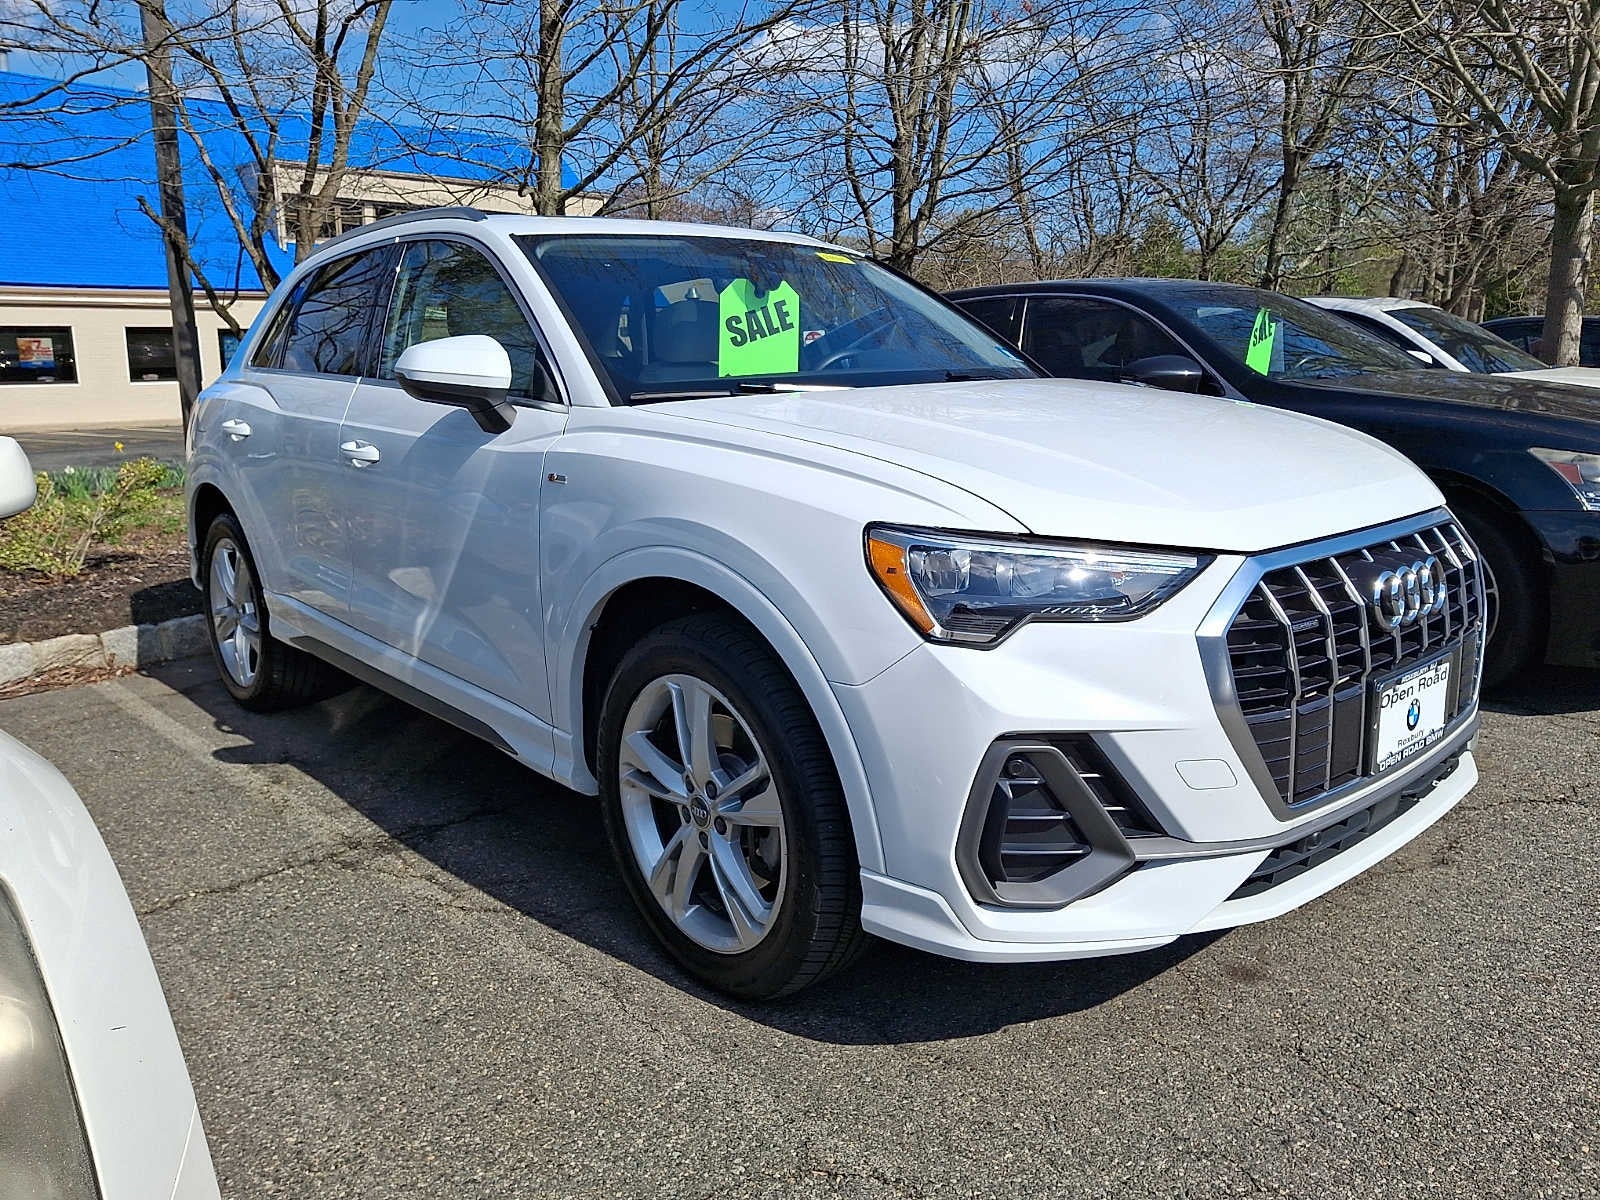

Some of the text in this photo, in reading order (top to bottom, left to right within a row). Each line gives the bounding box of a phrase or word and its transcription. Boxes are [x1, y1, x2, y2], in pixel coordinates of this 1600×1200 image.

[725, 299, 794, 347] SALE
[1252, 316, 1273, 347] SALE
[1380, 686, 1414, 708] Open
[1418, 667, 1447, 692] Road
[1379, 730, 1444, 772] OPEN ROAD BMW
